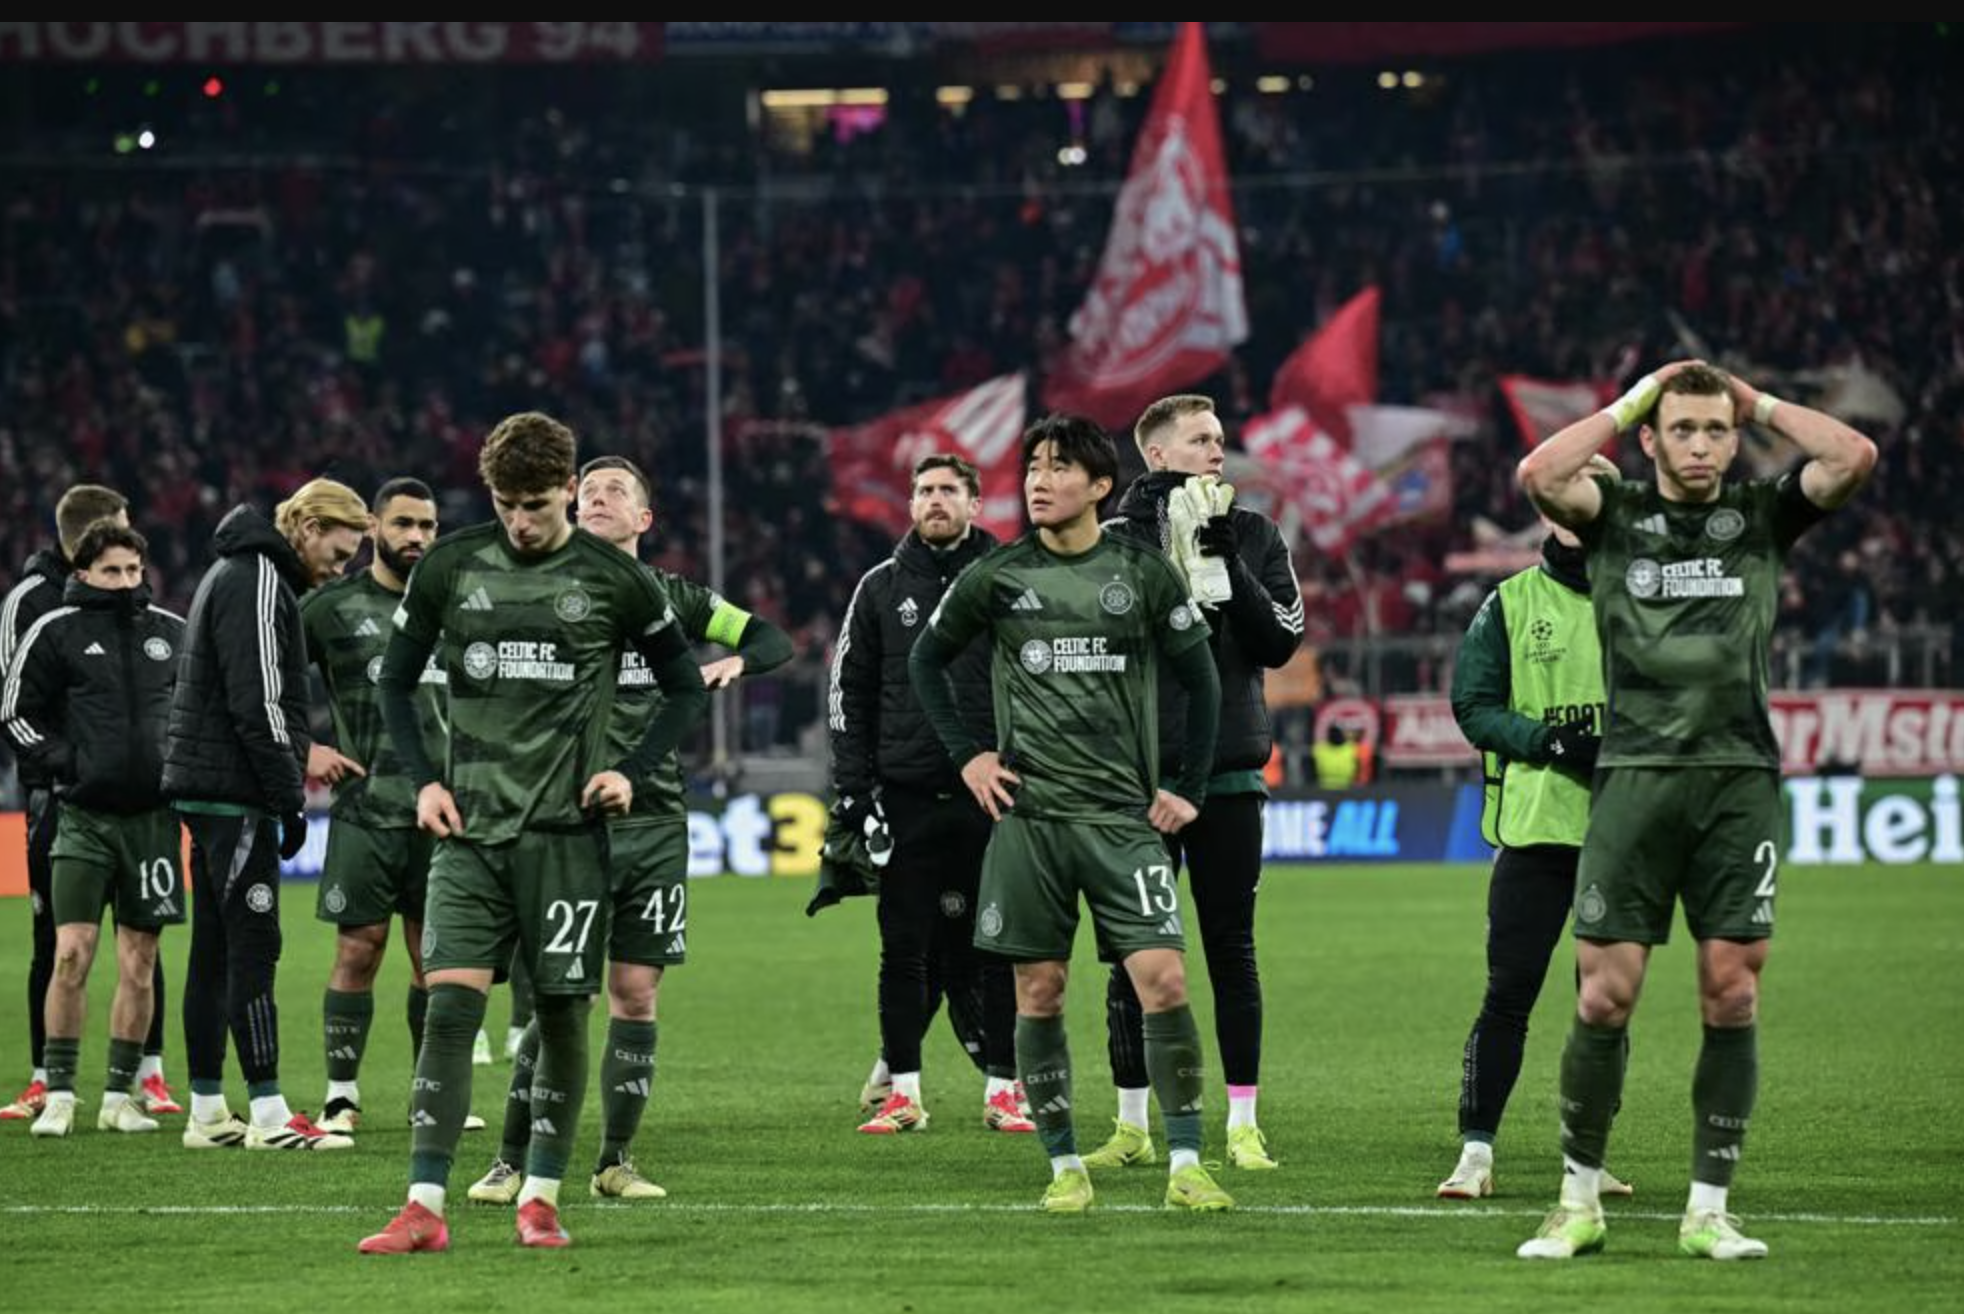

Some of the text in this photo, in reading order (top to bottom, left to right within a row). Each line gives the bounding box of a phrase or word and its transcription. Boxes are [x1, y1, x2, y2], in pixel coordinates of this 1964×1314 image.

[1662, 558, 1724, 578] CELTIC FC
[1663, 577, 1745, 598] FOUNDATION
[498, 641, 557, 661] CELTIC FC
[1053, 637, 1107, 655] CELTIC FC
[498, 660, 575, 681] FOUNDATION
[1054, 655, 1127, 672] FOUNDATION
[1326, 800, 1400, 856] ALL
[139, 857, 175, 900] 10
[1753, 840, 1777, 897] 2
[1133, 865, 1177, 917] 13
[639, 883, 686, 935] 42
[543, 899, 599, 953] 27
